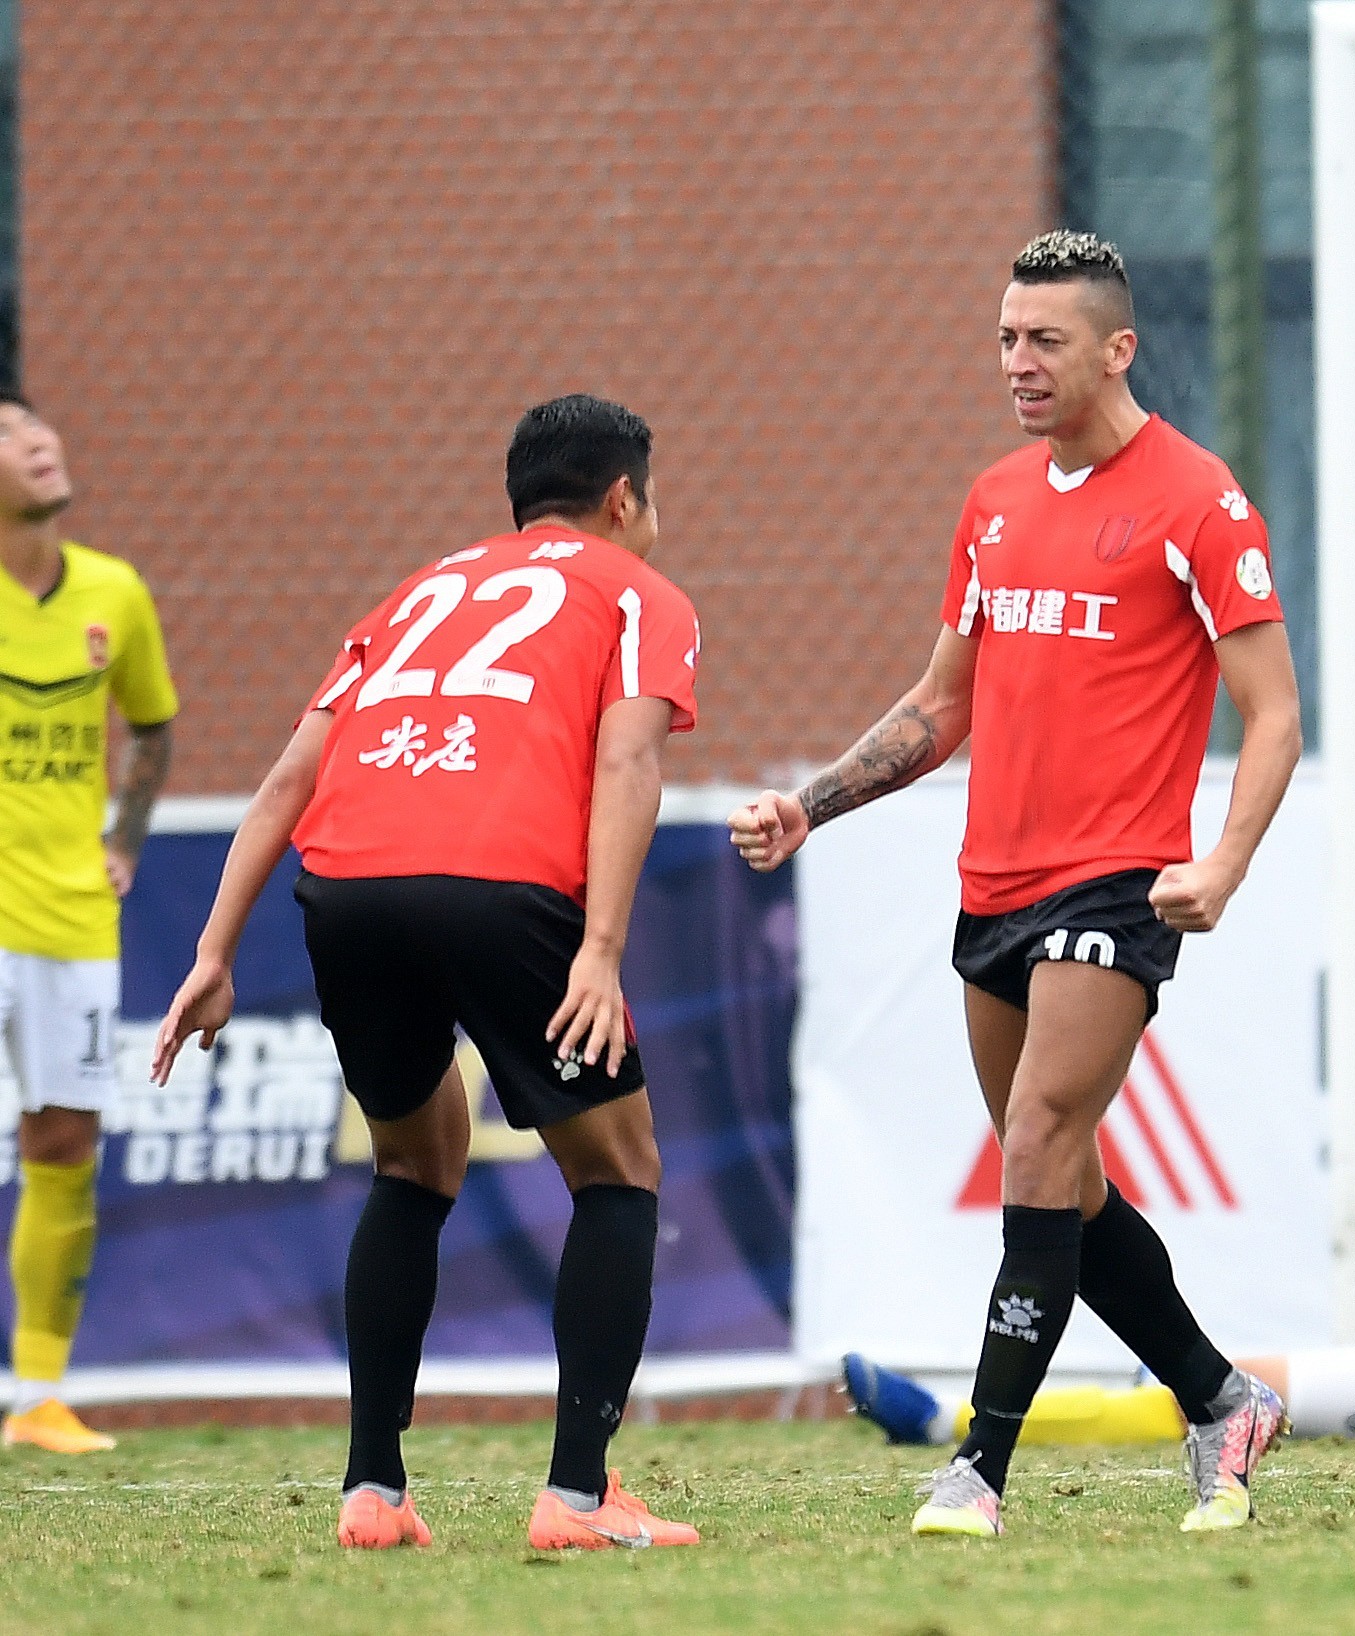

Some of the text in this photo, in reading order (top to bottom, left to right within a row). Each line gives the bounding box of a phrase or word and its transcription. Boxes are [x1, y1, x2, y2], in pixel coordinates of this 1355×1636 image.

[355, 565, 567, 713] 22
[358, 713, 477, 778] 尖庄
[125, 1132, 334, 1185] DERUI
